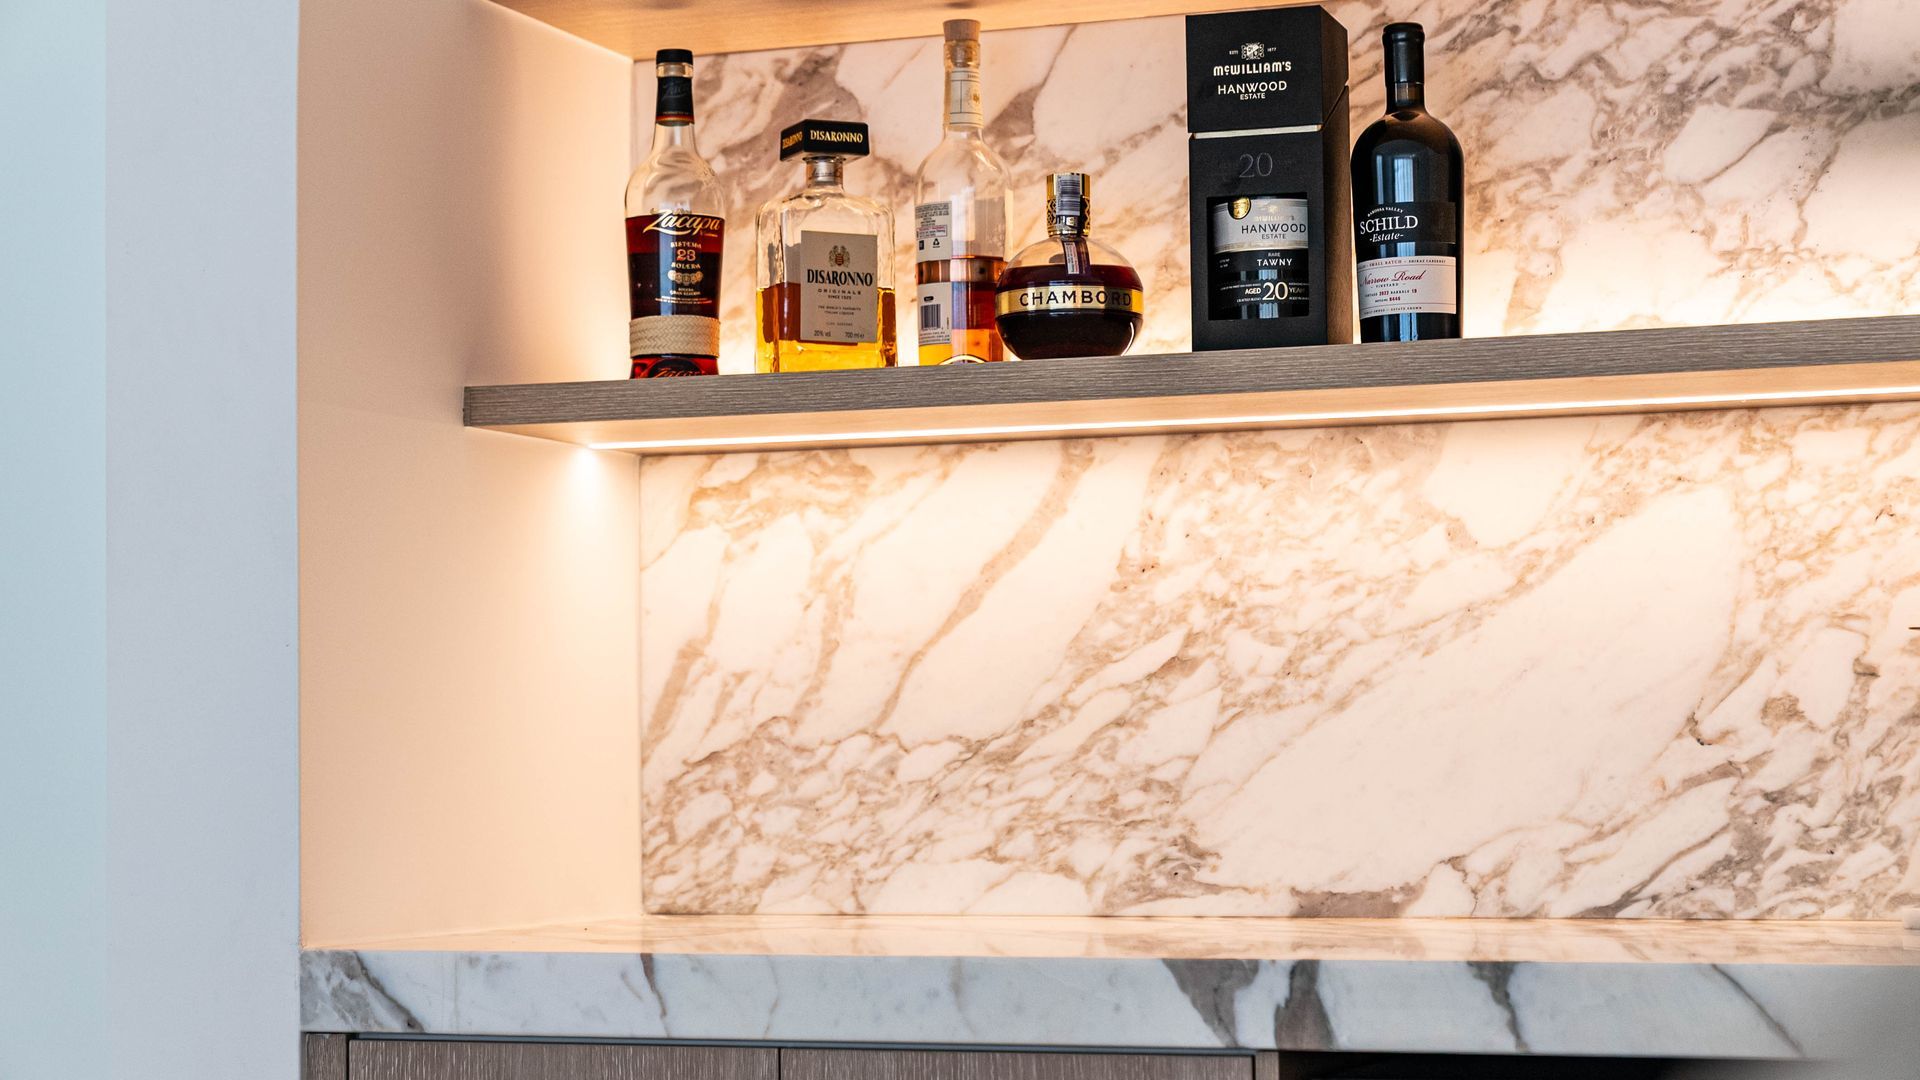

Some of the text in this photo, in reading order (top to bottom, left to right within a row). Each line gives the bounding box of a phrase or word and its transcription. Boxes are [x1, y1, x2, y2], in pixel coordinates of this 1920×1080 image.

[1217, 80, 1288, 95] HANWOOD
[1240, 92, 1266, 101] ESTATE
[810, 129, 864, 144] DISARONNO
[1239, 152, 1273, 178] 20
[1385, 206, 1404, 214] VALLEY
[642, 208, 721, 236] Zacapa
[1241, 223, 1307, 235] HANWOOD
[1359, 215, 1419, 235] SCHILD
[676, 248, 696, 261] 23
[1257, 258, 1293, 268] TAWNY
[807, 268, 874, 287] DISARONNO
[1391, 269, 1427, 282] Road
[1019, 290, 1132, 307] CHAMBORD
[1244, 287, 1262, 295] AGED
[1261, 281, 1289, 301] 20
